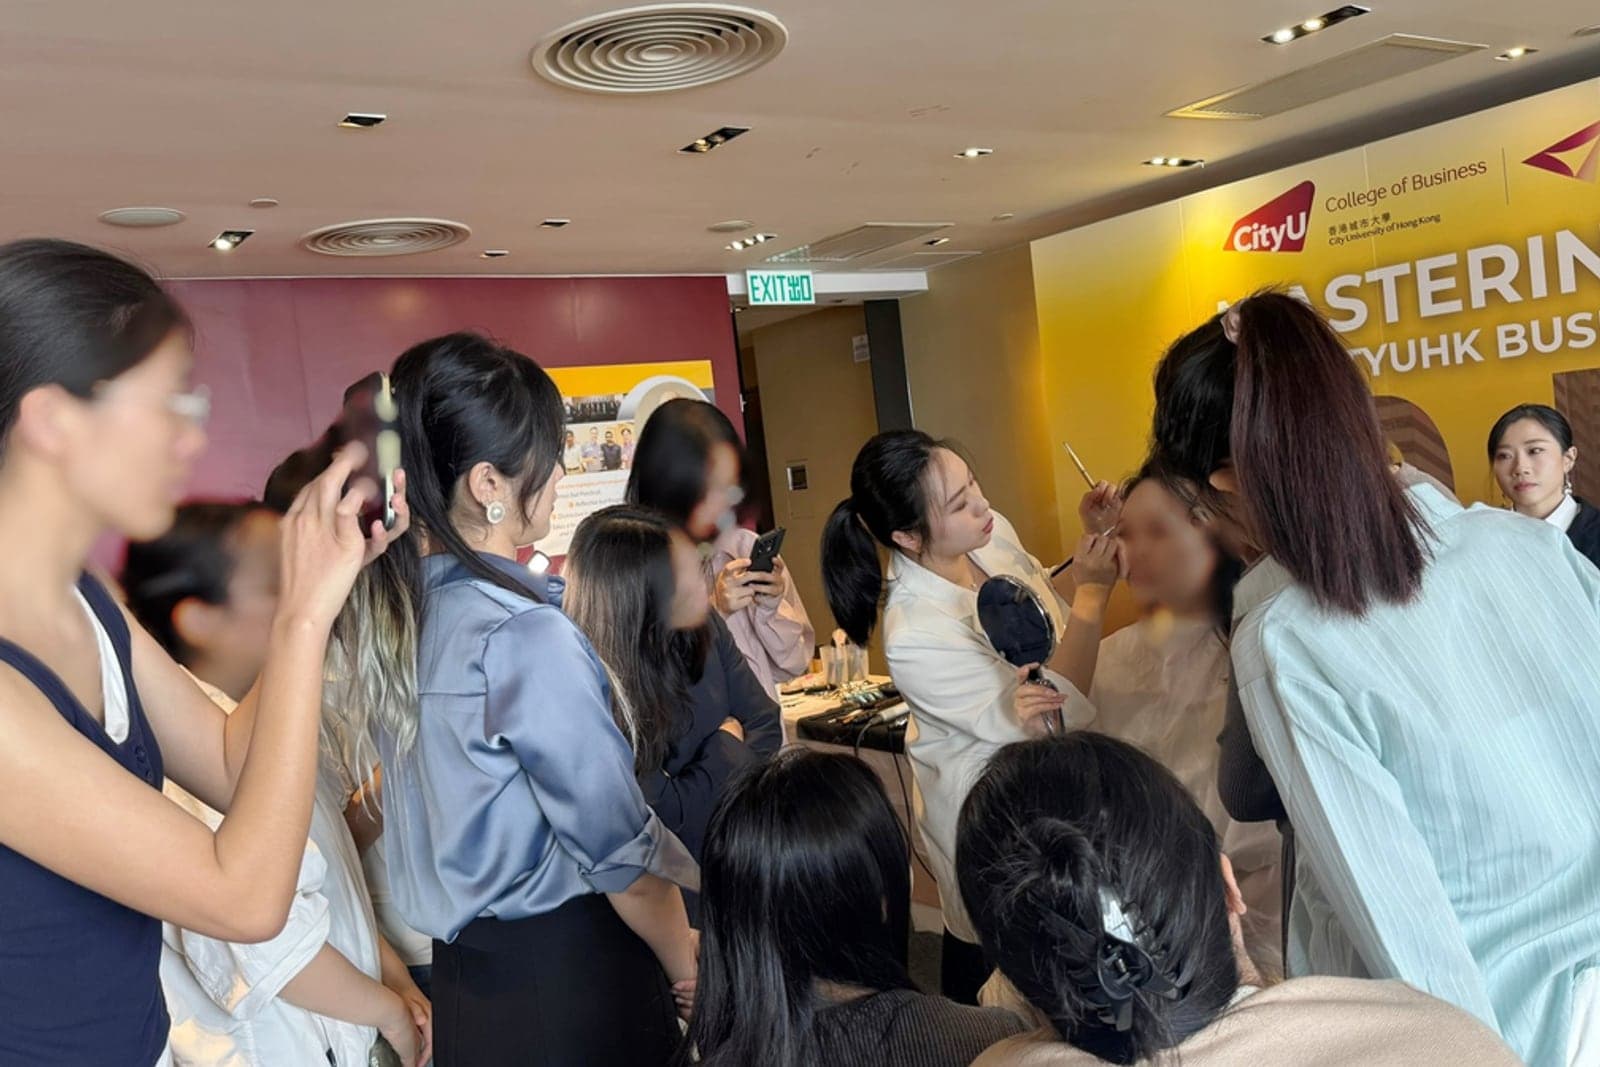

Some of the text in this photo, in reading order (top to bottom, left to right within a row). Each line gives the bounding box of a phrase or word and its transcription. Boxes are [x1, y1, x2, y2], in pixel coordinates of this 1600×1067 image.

[1325, 161, 1487, 213] College of Business
[1233, 211, 1306, 252] CityU
[1328, 212, 1391, 236] 香港城市大學
[1328, 236, 1345, 246] City
[1346, 227, 1385, 241] University
[1385, 222, 1396, 233] of
[1419, 213, 1440, 224] Kong
[750, 274, 812, 302] EXIT 出口
[1217, 229, 1600, 332] STERIN
[1496, 310, 1600, 359] BUS
